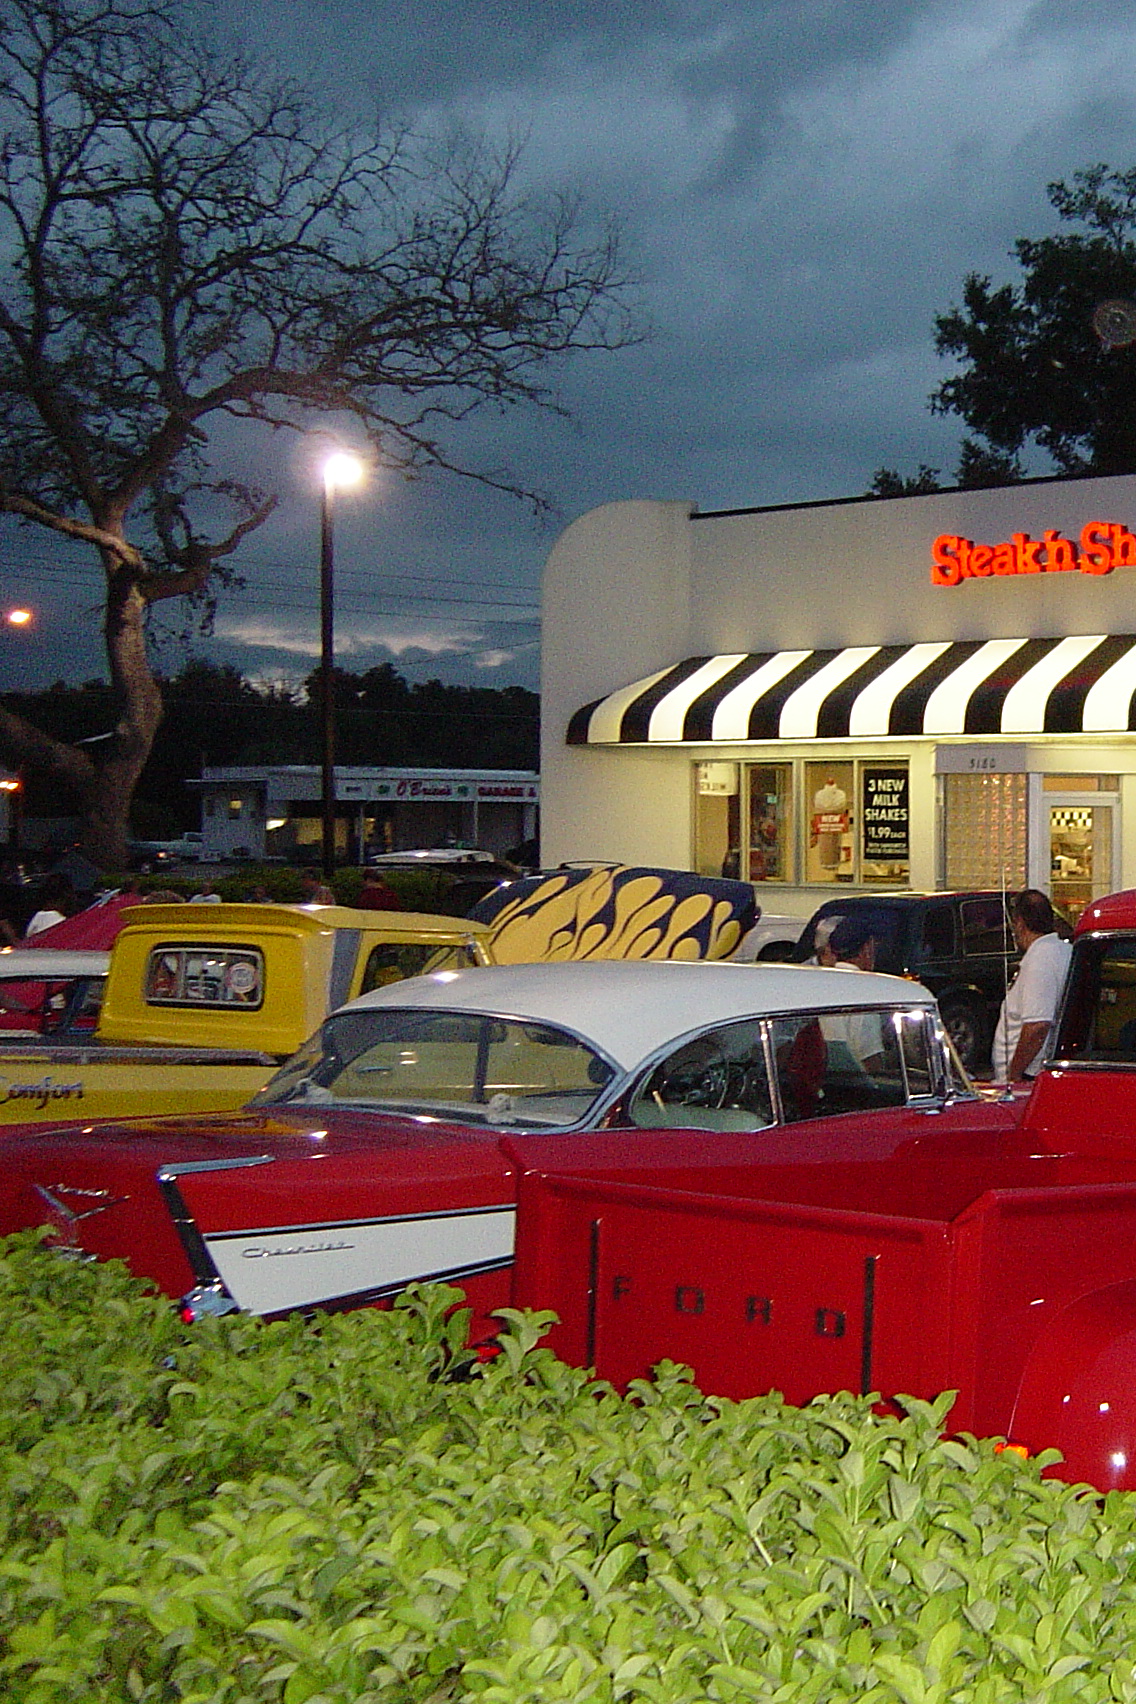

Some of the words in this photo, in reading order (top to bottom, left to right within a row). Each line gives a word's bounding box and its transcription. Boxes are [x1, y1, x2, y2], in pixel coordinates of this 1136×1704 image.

[868, 779, 876, 792] 3
[877, 779, 905, 792] NEW
[872, 794, 900, 806] MILK
[864, 808, 908, 821] SHAKES
[612, 1275, 846, 1340] FORD
